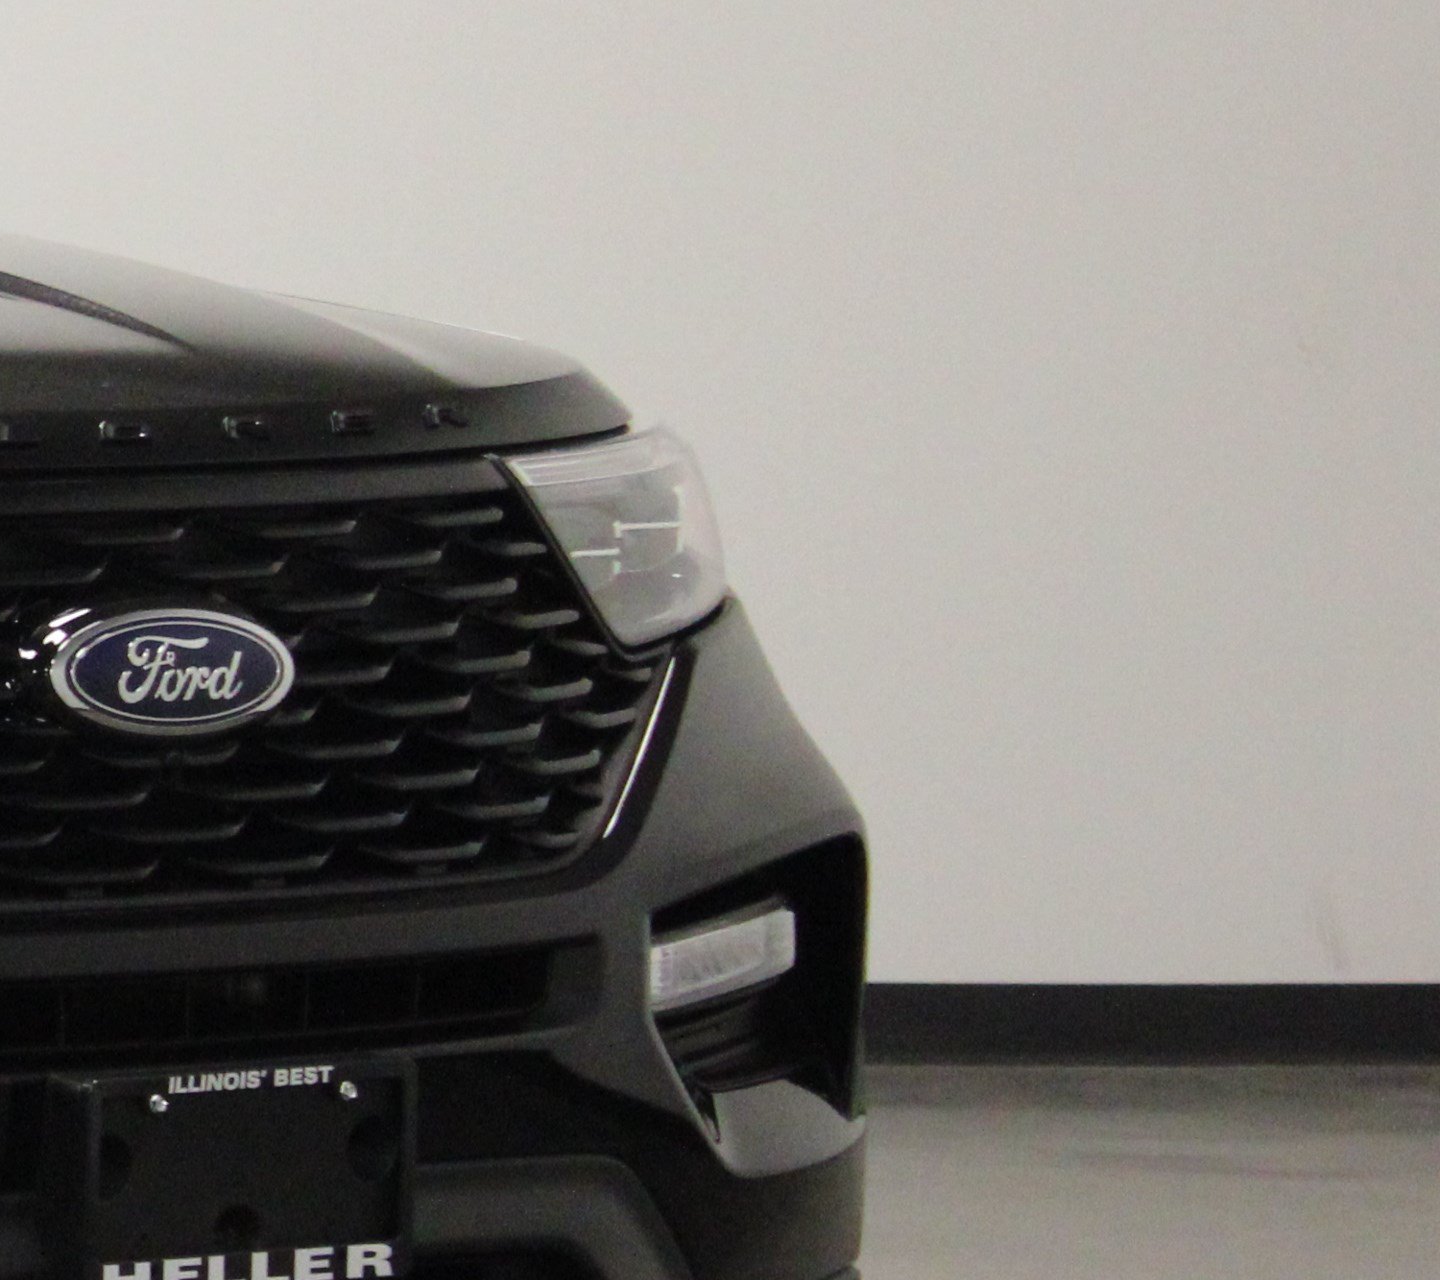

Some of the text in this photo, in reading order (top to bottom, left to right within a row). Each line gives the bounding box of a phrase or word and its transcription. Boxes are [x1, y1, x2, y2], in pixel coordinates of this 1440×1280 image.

[118, 635, 243, 704] Ford
[168, 1065, 334, 1094] ILLINOIS' BEST
